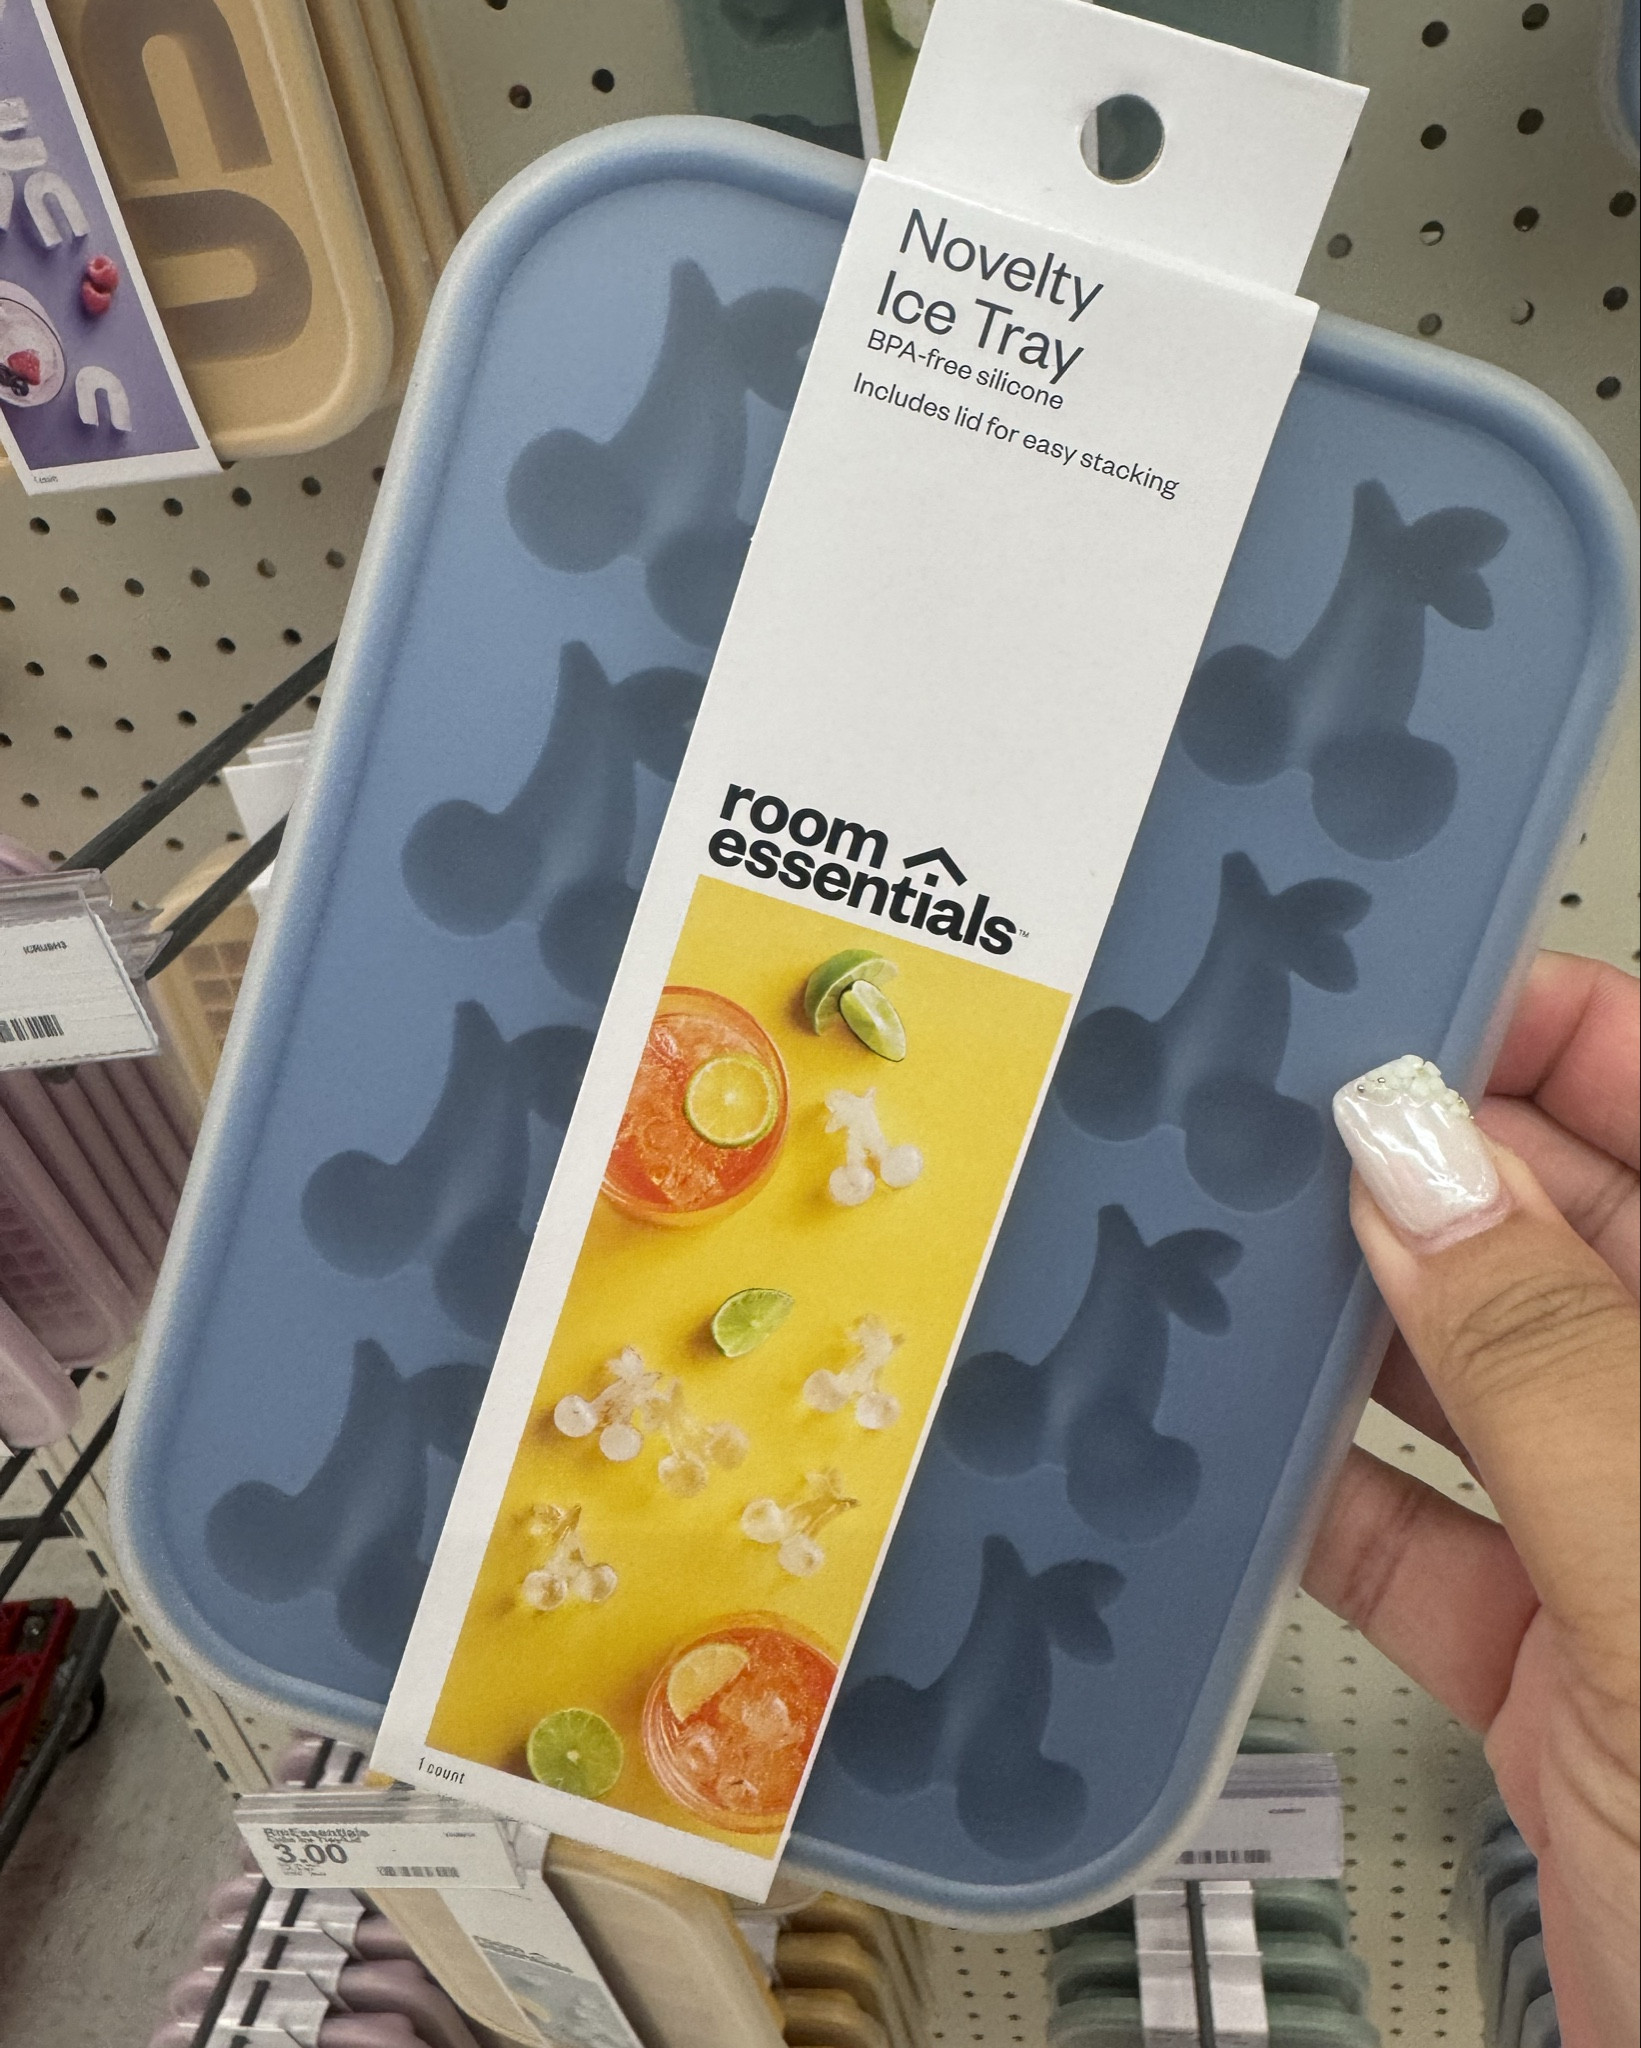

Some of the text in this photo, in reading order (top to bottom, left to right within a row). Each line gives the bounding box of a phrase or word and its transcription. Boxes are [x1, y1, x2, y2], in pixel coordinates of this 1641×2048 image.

[899, 208, 1105, 323] Novelty
[866, 328, 1064, 410] BPA-free silicone
[876, 269, 1085, 385] Ice Tray
[853, 372, 1181, 501] Includes lid for easy stacking
[719, 783, 889, 870] room
[708, 828, 1017, 956] essentials
[418, 1756, 467, 1785] 1 count
[273, 1843, 348, 1864] 3.00
